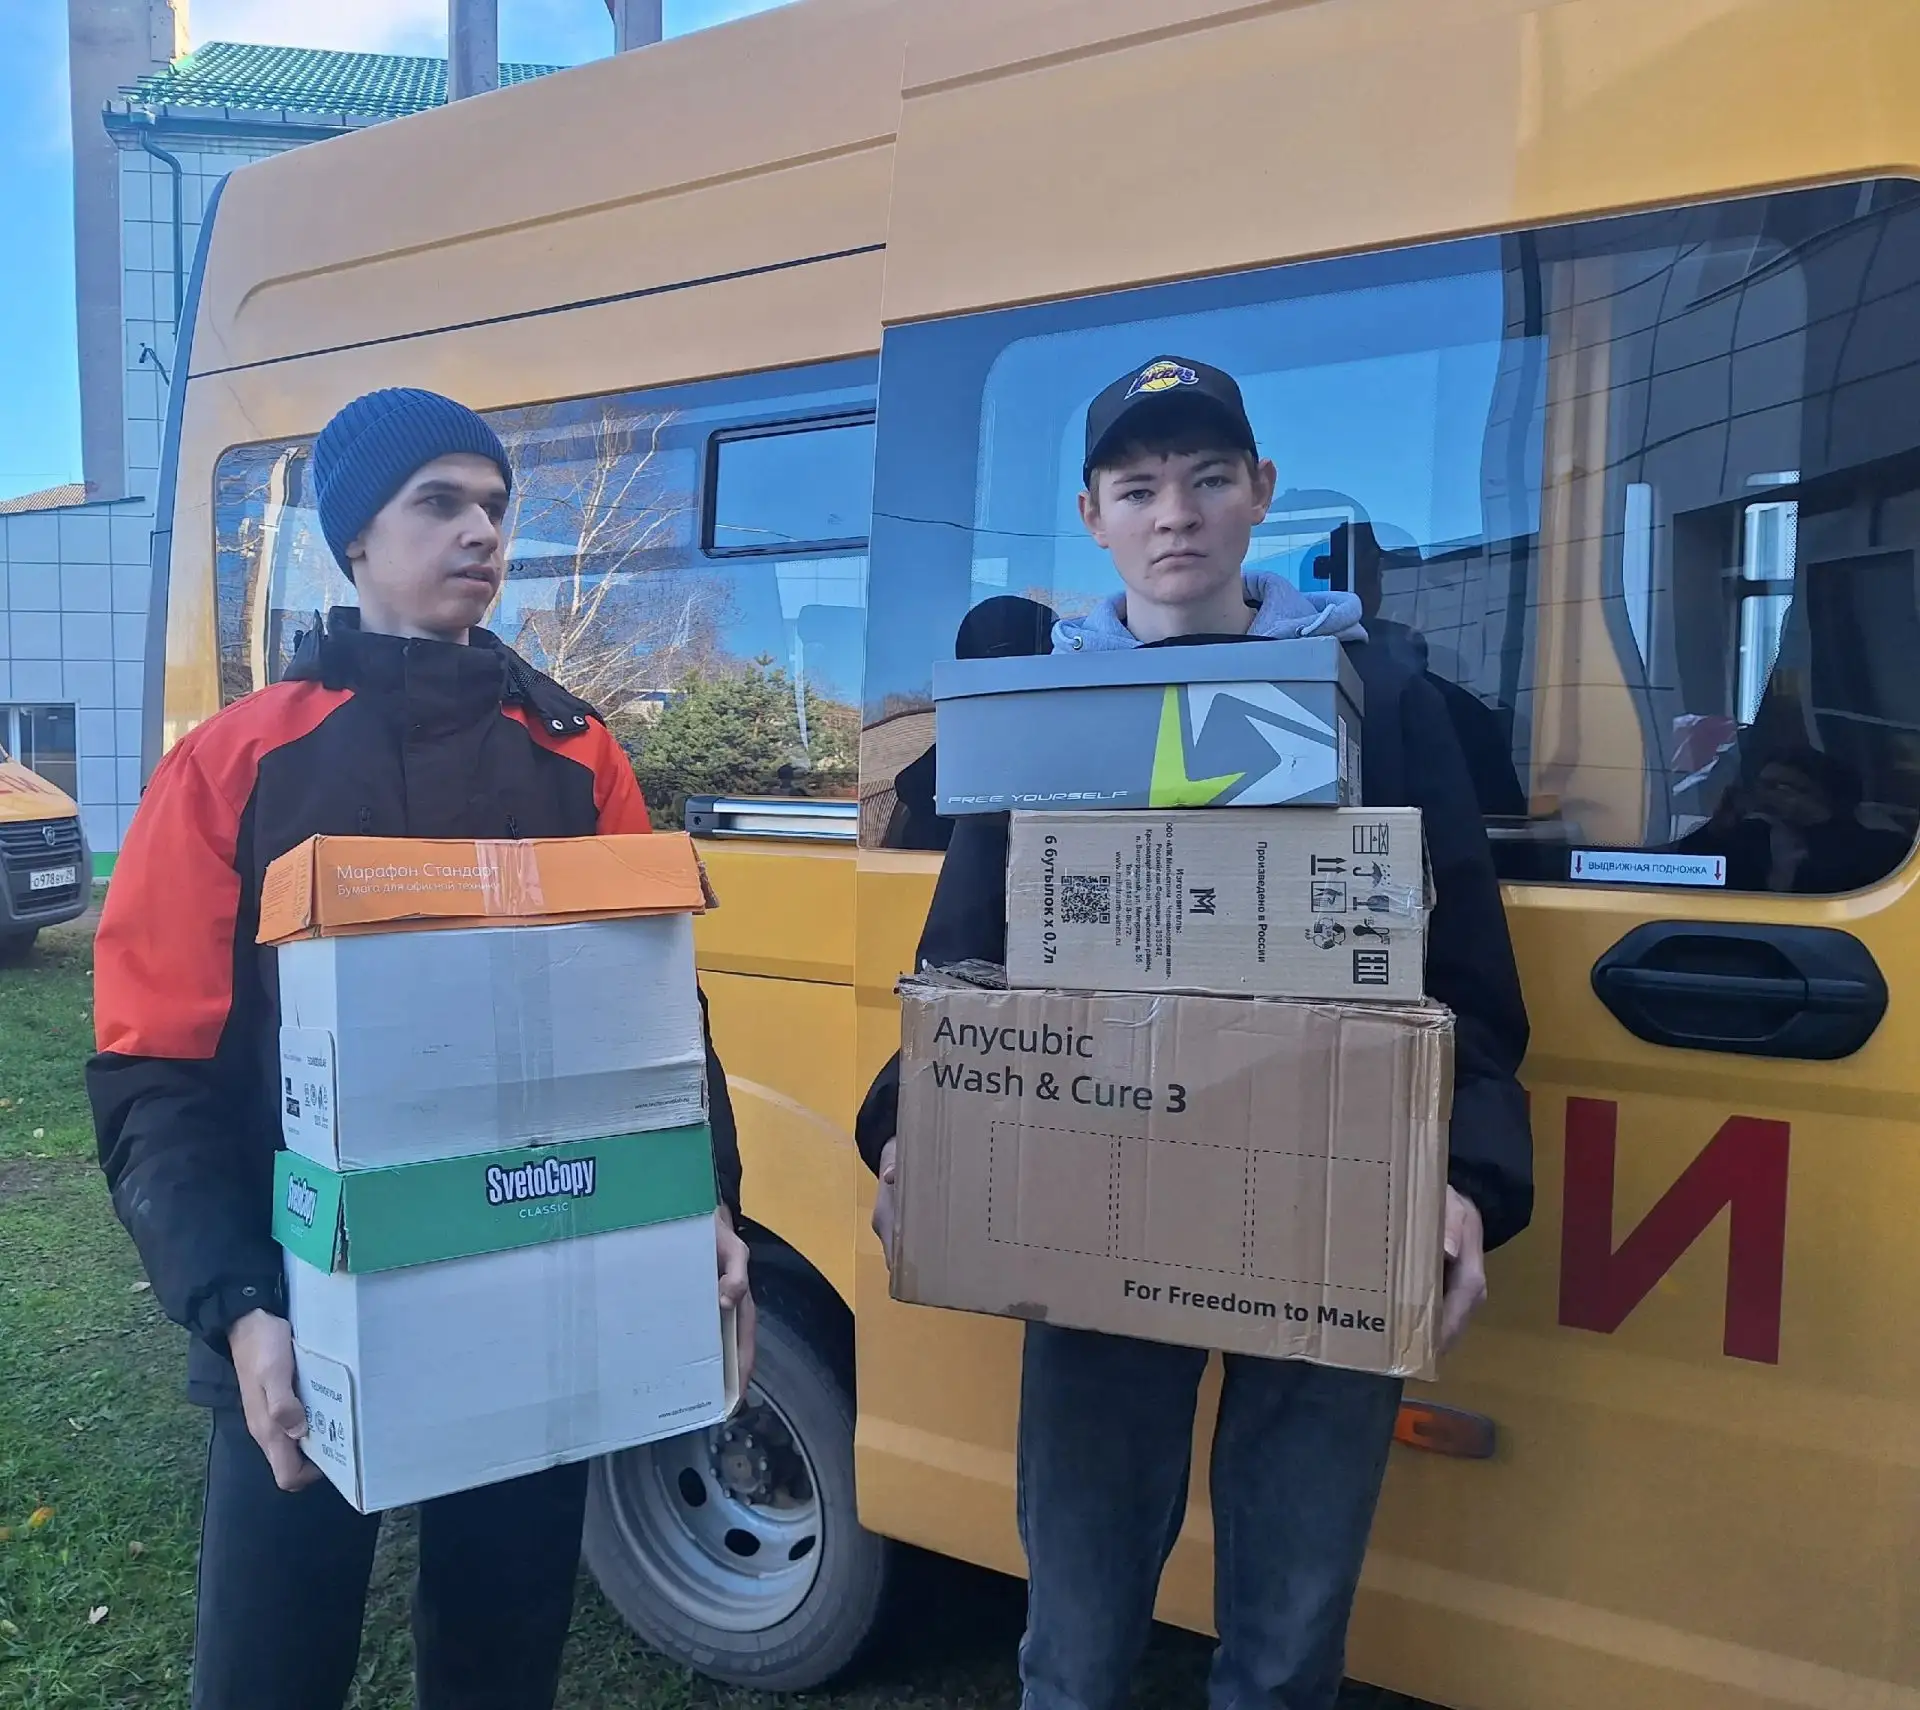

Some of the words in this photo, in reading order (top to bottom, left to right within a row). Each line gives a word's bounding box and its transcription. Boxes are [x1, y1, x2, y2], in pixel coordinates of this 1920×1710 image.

[947, 795, 1004, 804] FREE
[1011, 790, 1129, 802] YOURSELF
[1045, 835, 1057, 844] 6
[1144, 829, 1152, 883] Краснодарский
[337, 864, 418, 882] Марафон
[422, 863, 499, 879] Стандарт
[1041, 848, 1058, 916] бутылок
[1256, 841, 1268, 913] Произведено
[1588, 861, 1650, 872] ВЫДВИЖНАЯ
[1652, 864, 1708, 875] ПОДНОЖКА
[338, 884, 380, 898] Бумага
[383, 882, 404, 893] для
[406, 881, 455, 893] офисной
[1175, 868, 1184, 934] Изготовитель:
[1043, 932, 1056, 964] 0,7л
[1144, 948, 1152, 972] район,
[1258, 924, 1268, 963] России
[933, 1016, 1094, 1058] Anycubic
[932, 1060, 1024, 1098] Wash
[1036, 1072, 1060, 1102] &
[1071, 1074, 1154, 1112] Cure
[1166, 1083, 1187, 1113] 3
[486, 1157, 596, 1205] SvetoCopy
[518, 1202, 569, 1218] CLASSIC
[1123, 1279, 1162, 1302] For
[1168, 1284, 1277, 1320] Freedom
[1284, 1302, 1309, 1324] to
[1316, 1306, 1386, 1334] Make
